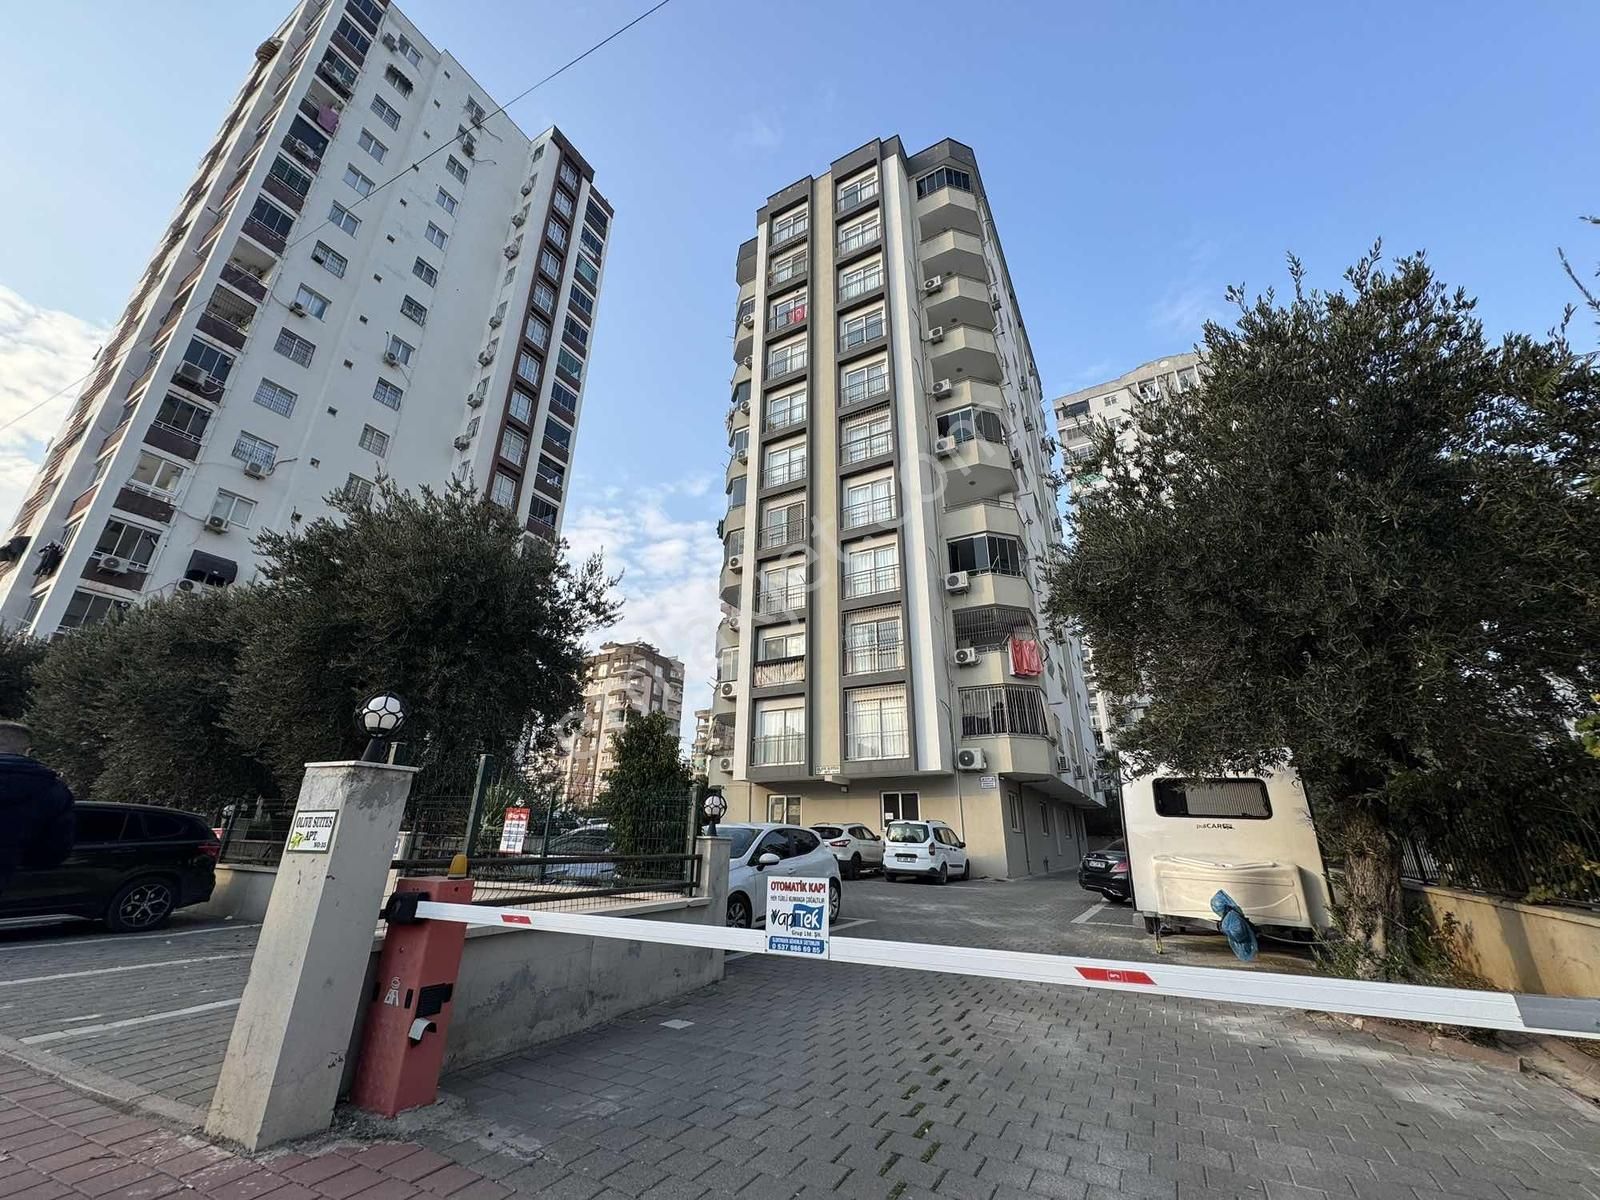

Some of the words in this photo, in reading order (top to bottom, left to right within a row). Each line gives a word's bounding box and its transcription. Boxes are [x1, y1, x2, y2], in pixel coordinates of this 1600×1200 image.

[296, 816, 313, 828] OLIVE
[313, 816, 333, 828] SUITES
[770, 880, 807, 893] OTOMATİK
[808, 882, 826, 893] KAPI
